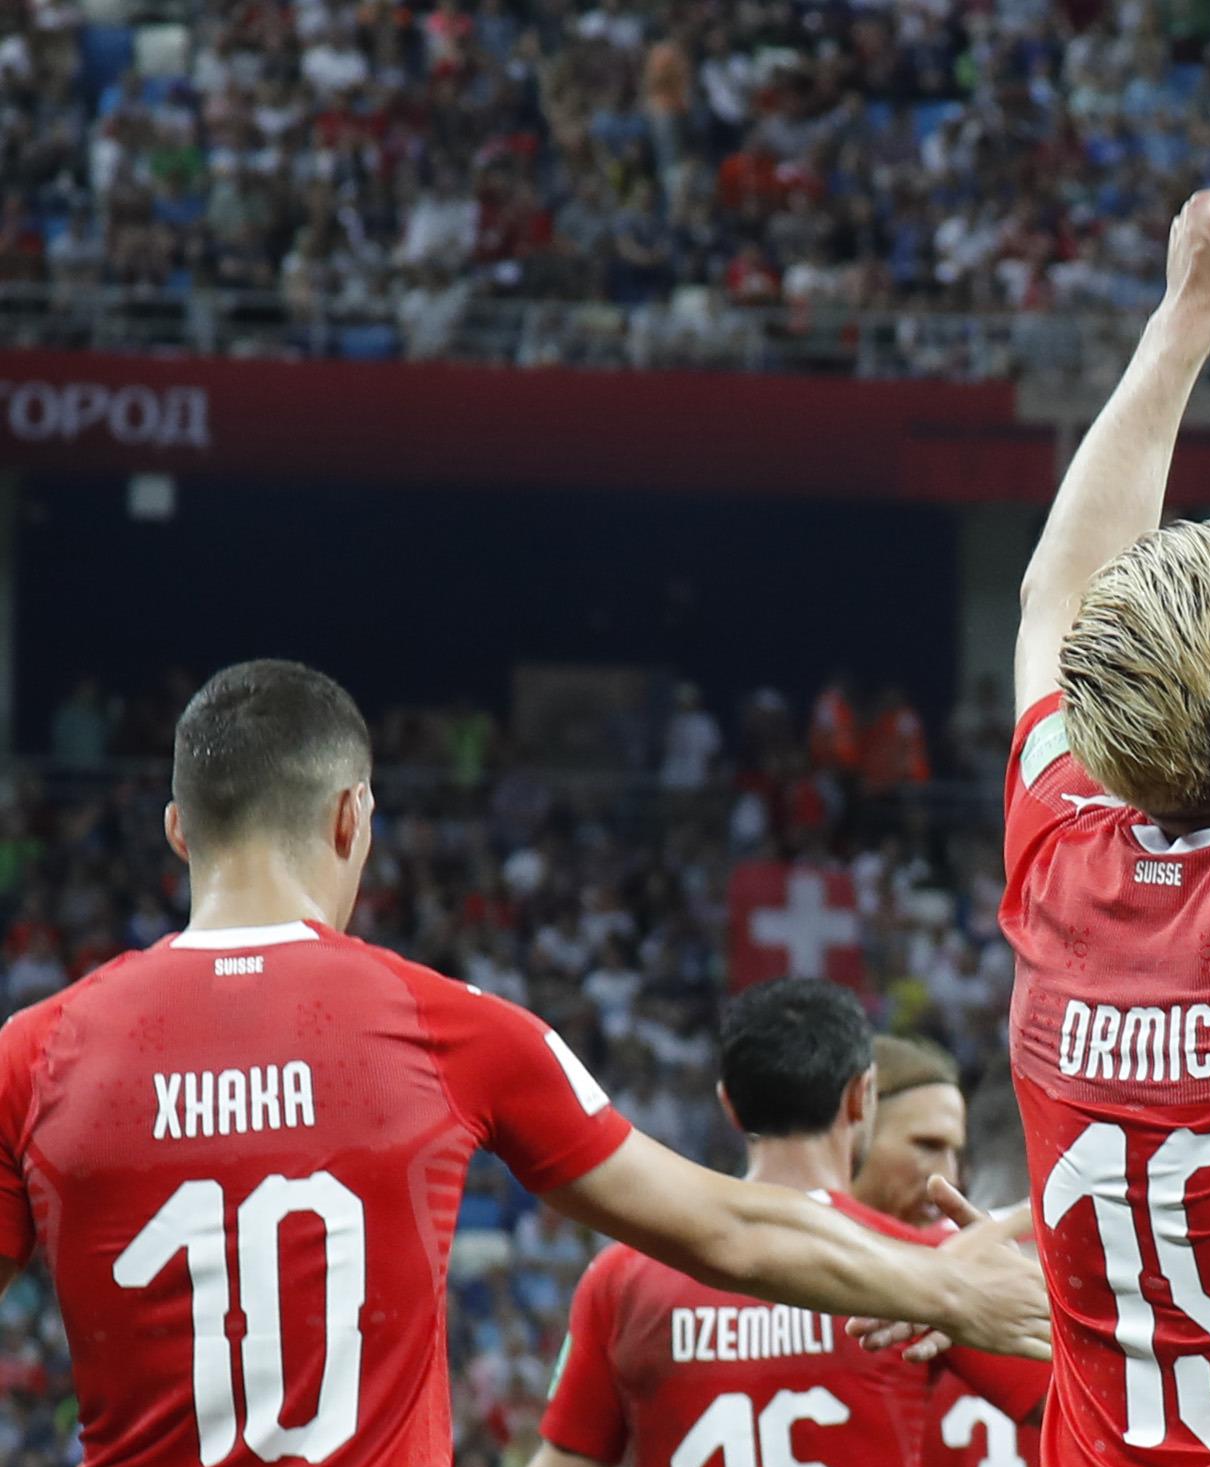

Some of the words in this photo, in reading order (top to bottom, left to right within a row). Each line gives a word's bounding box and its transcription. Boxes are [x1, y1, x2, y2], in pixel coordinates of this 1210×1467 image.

[0, 380, 209, 447] ОРОД
[1134, 860, 1183, 887] SUISSE
[214, 955, 264, 976] SUISSE
[153, 1061, 316, 1139] XHAKA
[113, 1171, 366, 1467] 10
[672, 1303, 834, 1362] DZEMAILI
